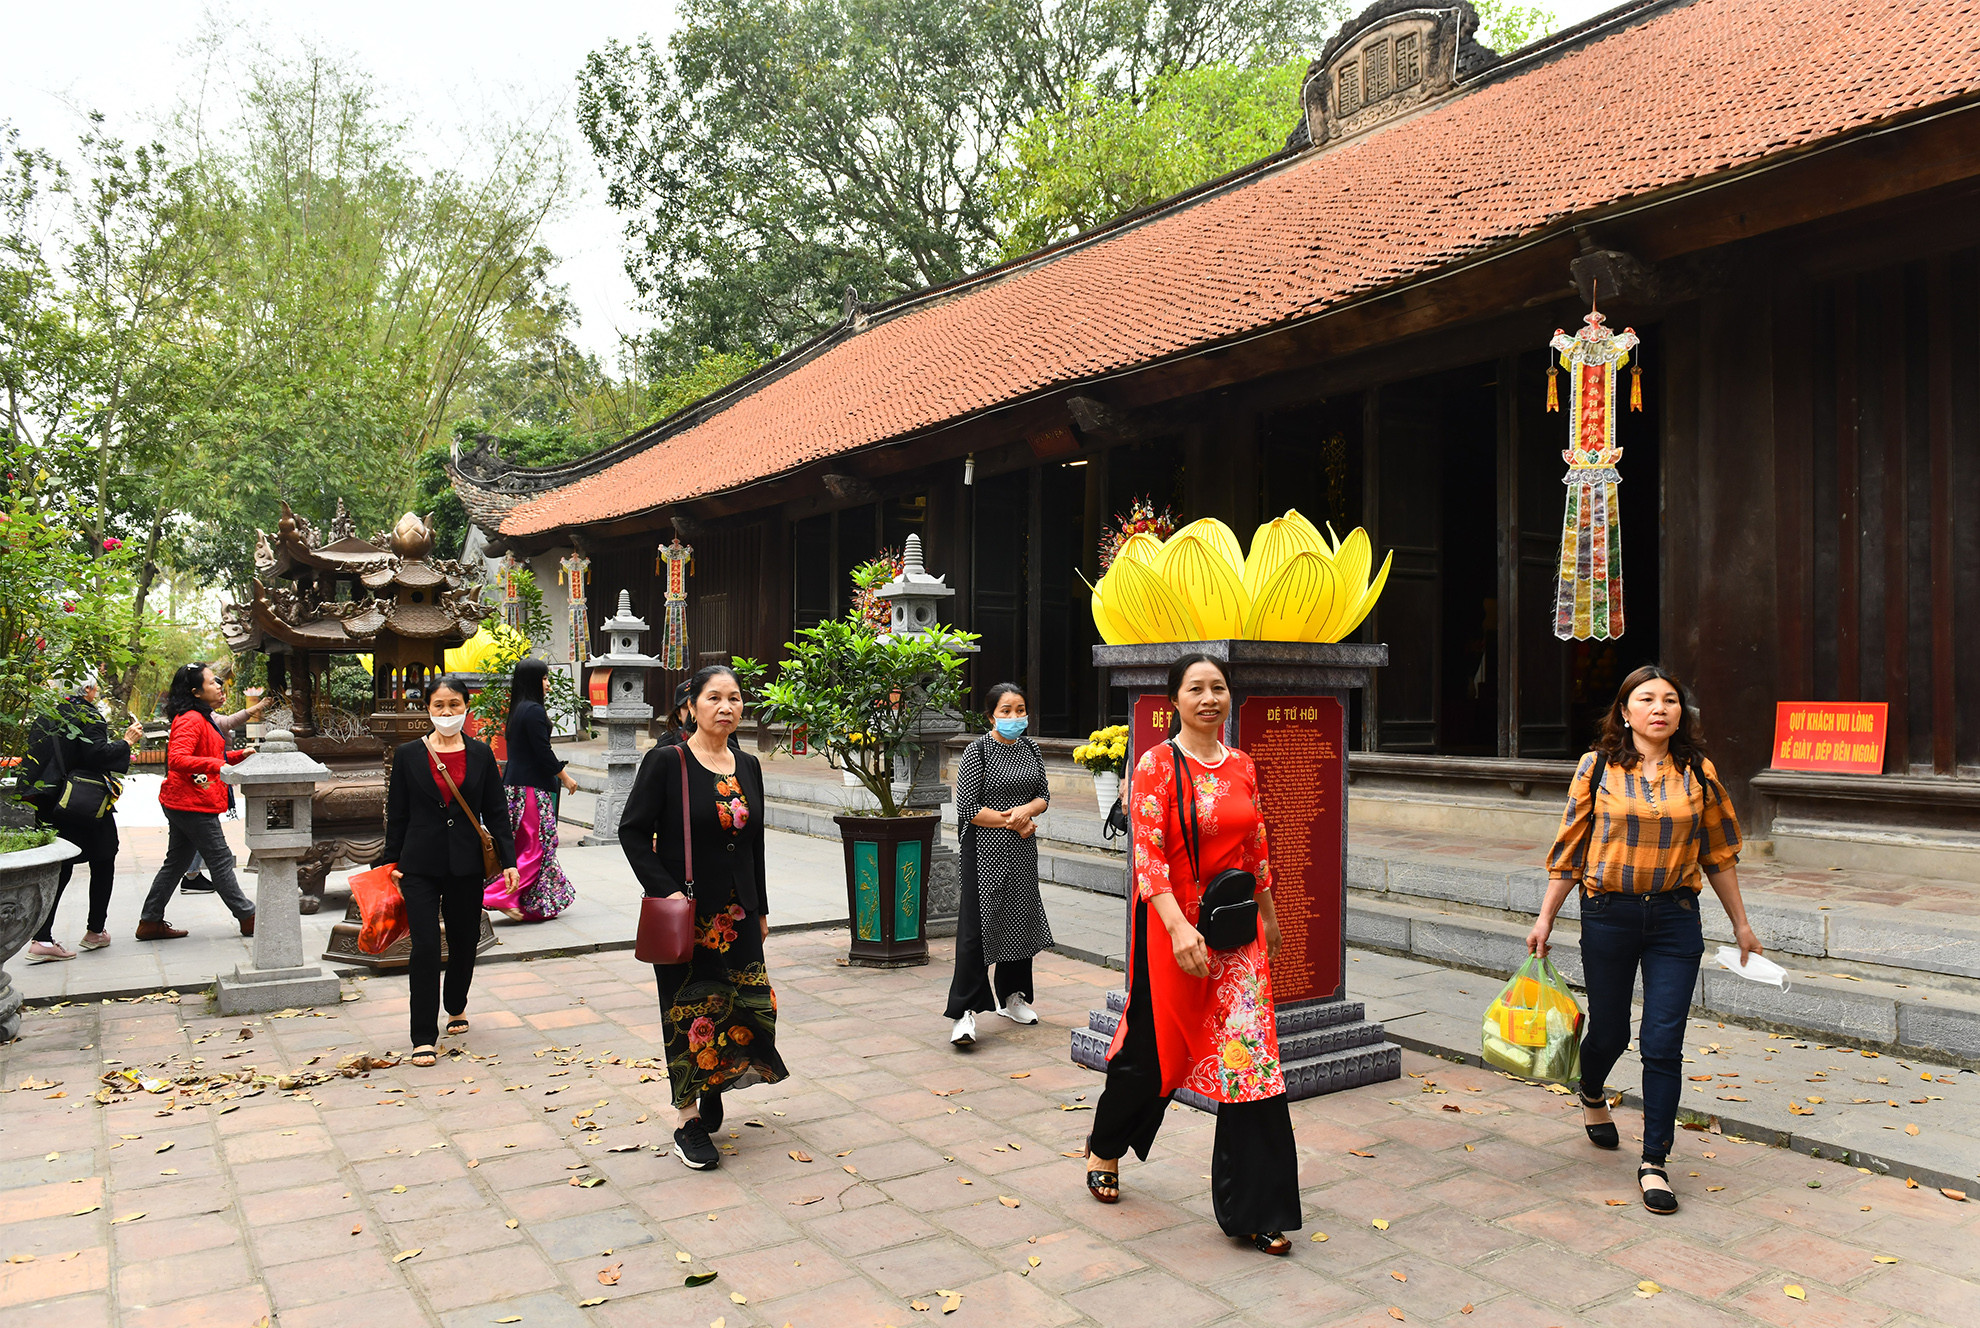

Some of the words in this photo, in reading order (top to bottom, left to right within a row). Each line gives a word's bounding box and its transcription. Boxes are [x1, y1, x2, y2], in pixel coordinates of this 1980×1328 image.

[407, 719, 428, 729] ĐỨC
[1152, 707, 1164, 732] ĐỆ
[1166, 711, 1173, 728] T
[1267, 706, 1281, 723] ĐỆ
[1284, 706, 1298, 720] TỨ
[1300, 706, 1318, 723] HỘI
[1789, 709, 1806, 732] QUÝ
[1806, 710, 1835, 732] KHÁCH
[1836, 713, 1850, 732] VUI
[1851, 710, 1874, 732] LÒNG
[1780, 735, 1794, 759] ĐỂ
[1792, 739, 1813, 762] GIÀY,
[1815, 740, 1832, 760] DÉP
[1833, 740, 1851, 761] BÊN
[1851, 741, 1879, 763] NGOÀI
